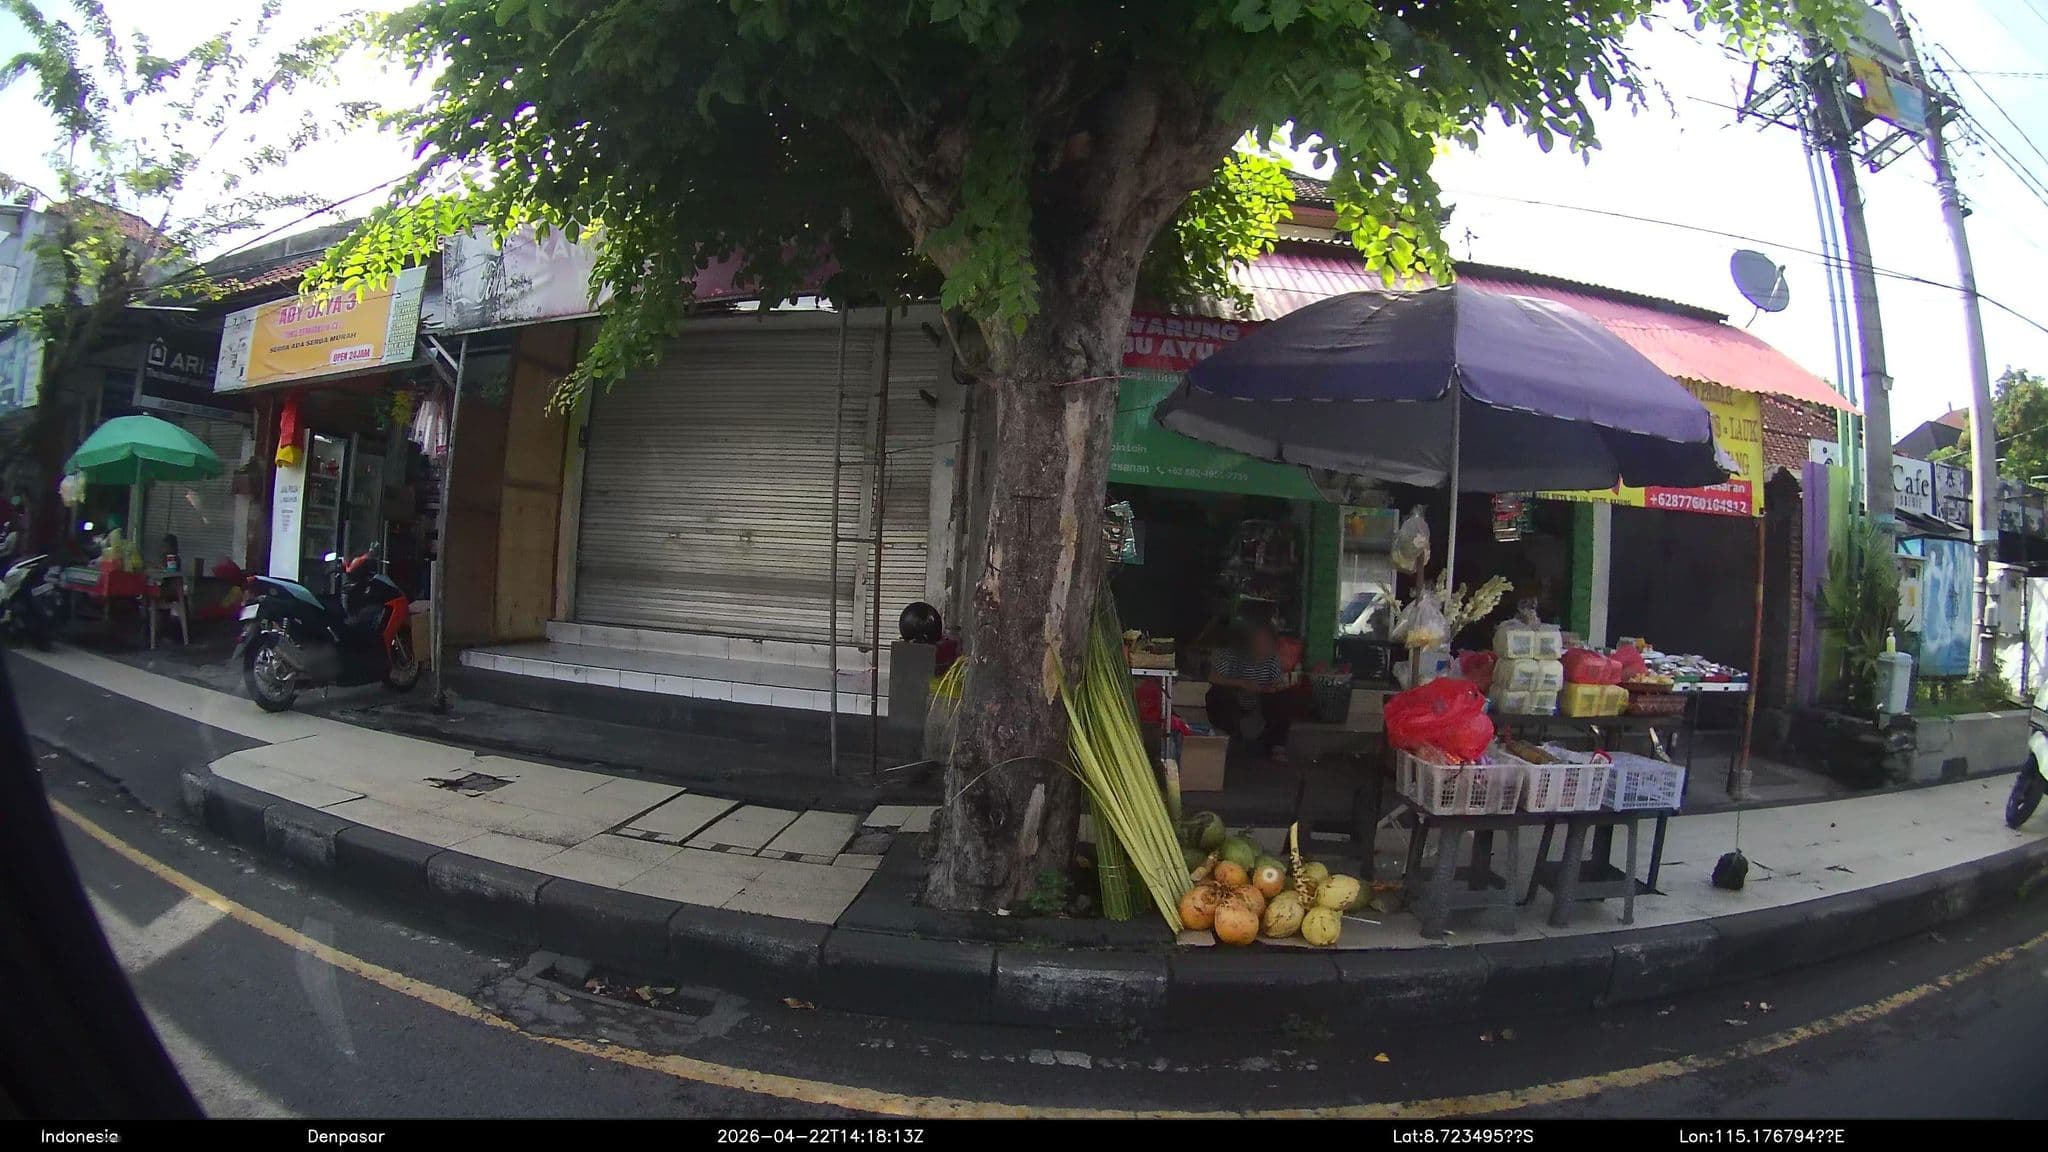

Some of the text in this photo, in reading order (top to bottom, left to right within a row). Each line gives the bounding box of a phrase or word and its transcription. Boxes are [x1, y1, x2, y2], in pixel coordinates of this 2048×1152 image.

[346, 292, 357, 310] 3
[333, 352, 347, 362] OPEN
[1159, 339, 1214, 360] AYU
[1111, 462, 1149, 473] esanan
[1893, 464, 1929, 497] Cafe
